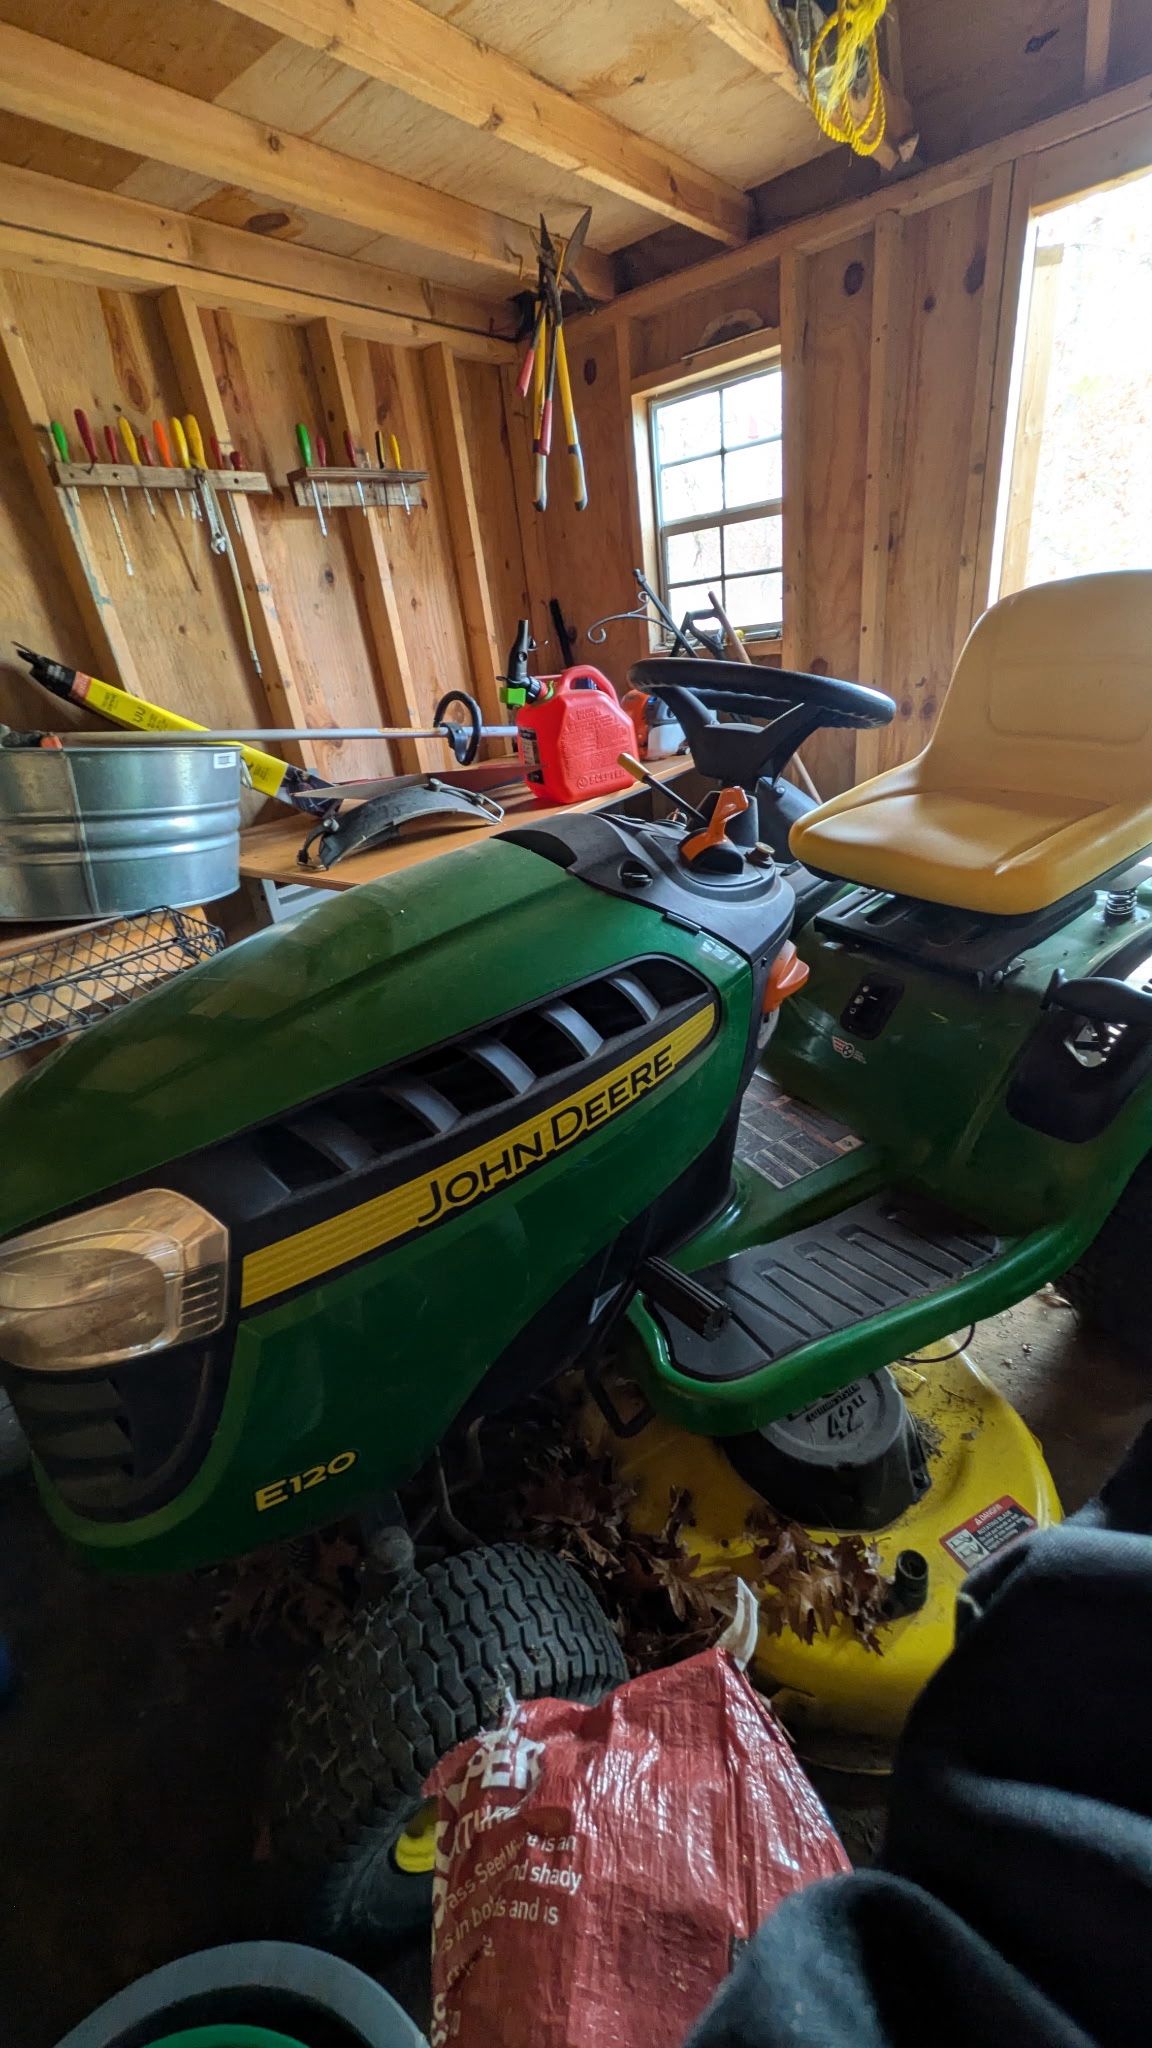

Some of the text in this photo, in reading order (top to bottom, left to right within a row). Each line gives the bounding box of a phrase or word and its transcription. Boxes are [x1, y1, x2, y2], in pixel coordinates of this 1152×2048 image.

[417, 1132, 544, 1224] JOHN
[551, 1043, 674, 1147] DEERE
[255, 1451, 357, 1513] E120
[444, 1878, 477, 1910] ass
[511, 1858, 583, 1897] nd shady
[509, 1896, 540, 1923] and
[543, 1898, 560, 1927] is
